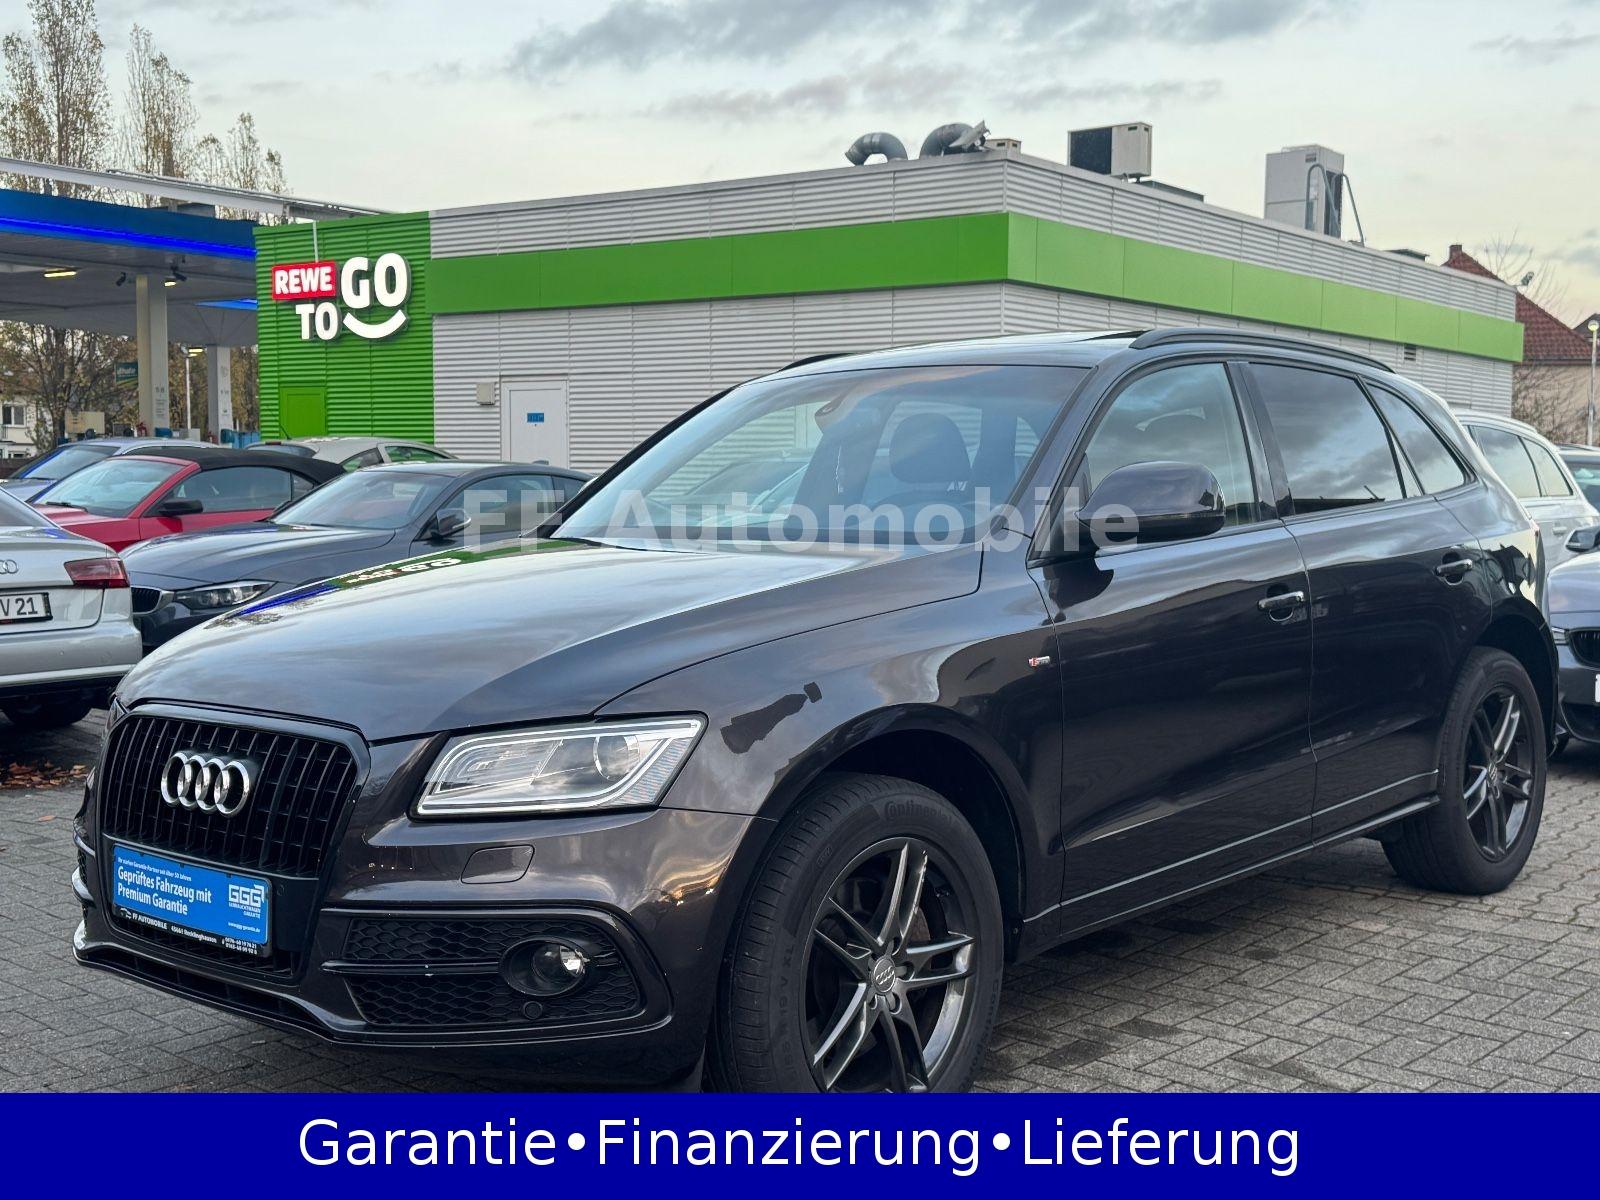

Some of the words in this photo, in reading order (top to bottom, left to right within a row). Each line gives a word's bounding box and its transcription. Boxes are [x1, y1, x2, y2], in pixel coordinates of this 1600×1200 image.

[275, 266, 332, 294] REWE
[296, 302, 338, 340] TO
[341, 253, 407, 309] GO
[15, 597, 38, 616] 21
[118, 866, 155, 888] Geprüftes
[155, 876, 194, 903] Fahrzeug
[196, 888, 212, 904] mit
[118, 882, 151, 905] Premium
[152, 893, 188, 915] Garantie
[229, 884, 264, 908] GGG
[138, 915, 167, 930] AUTOMOBILE
